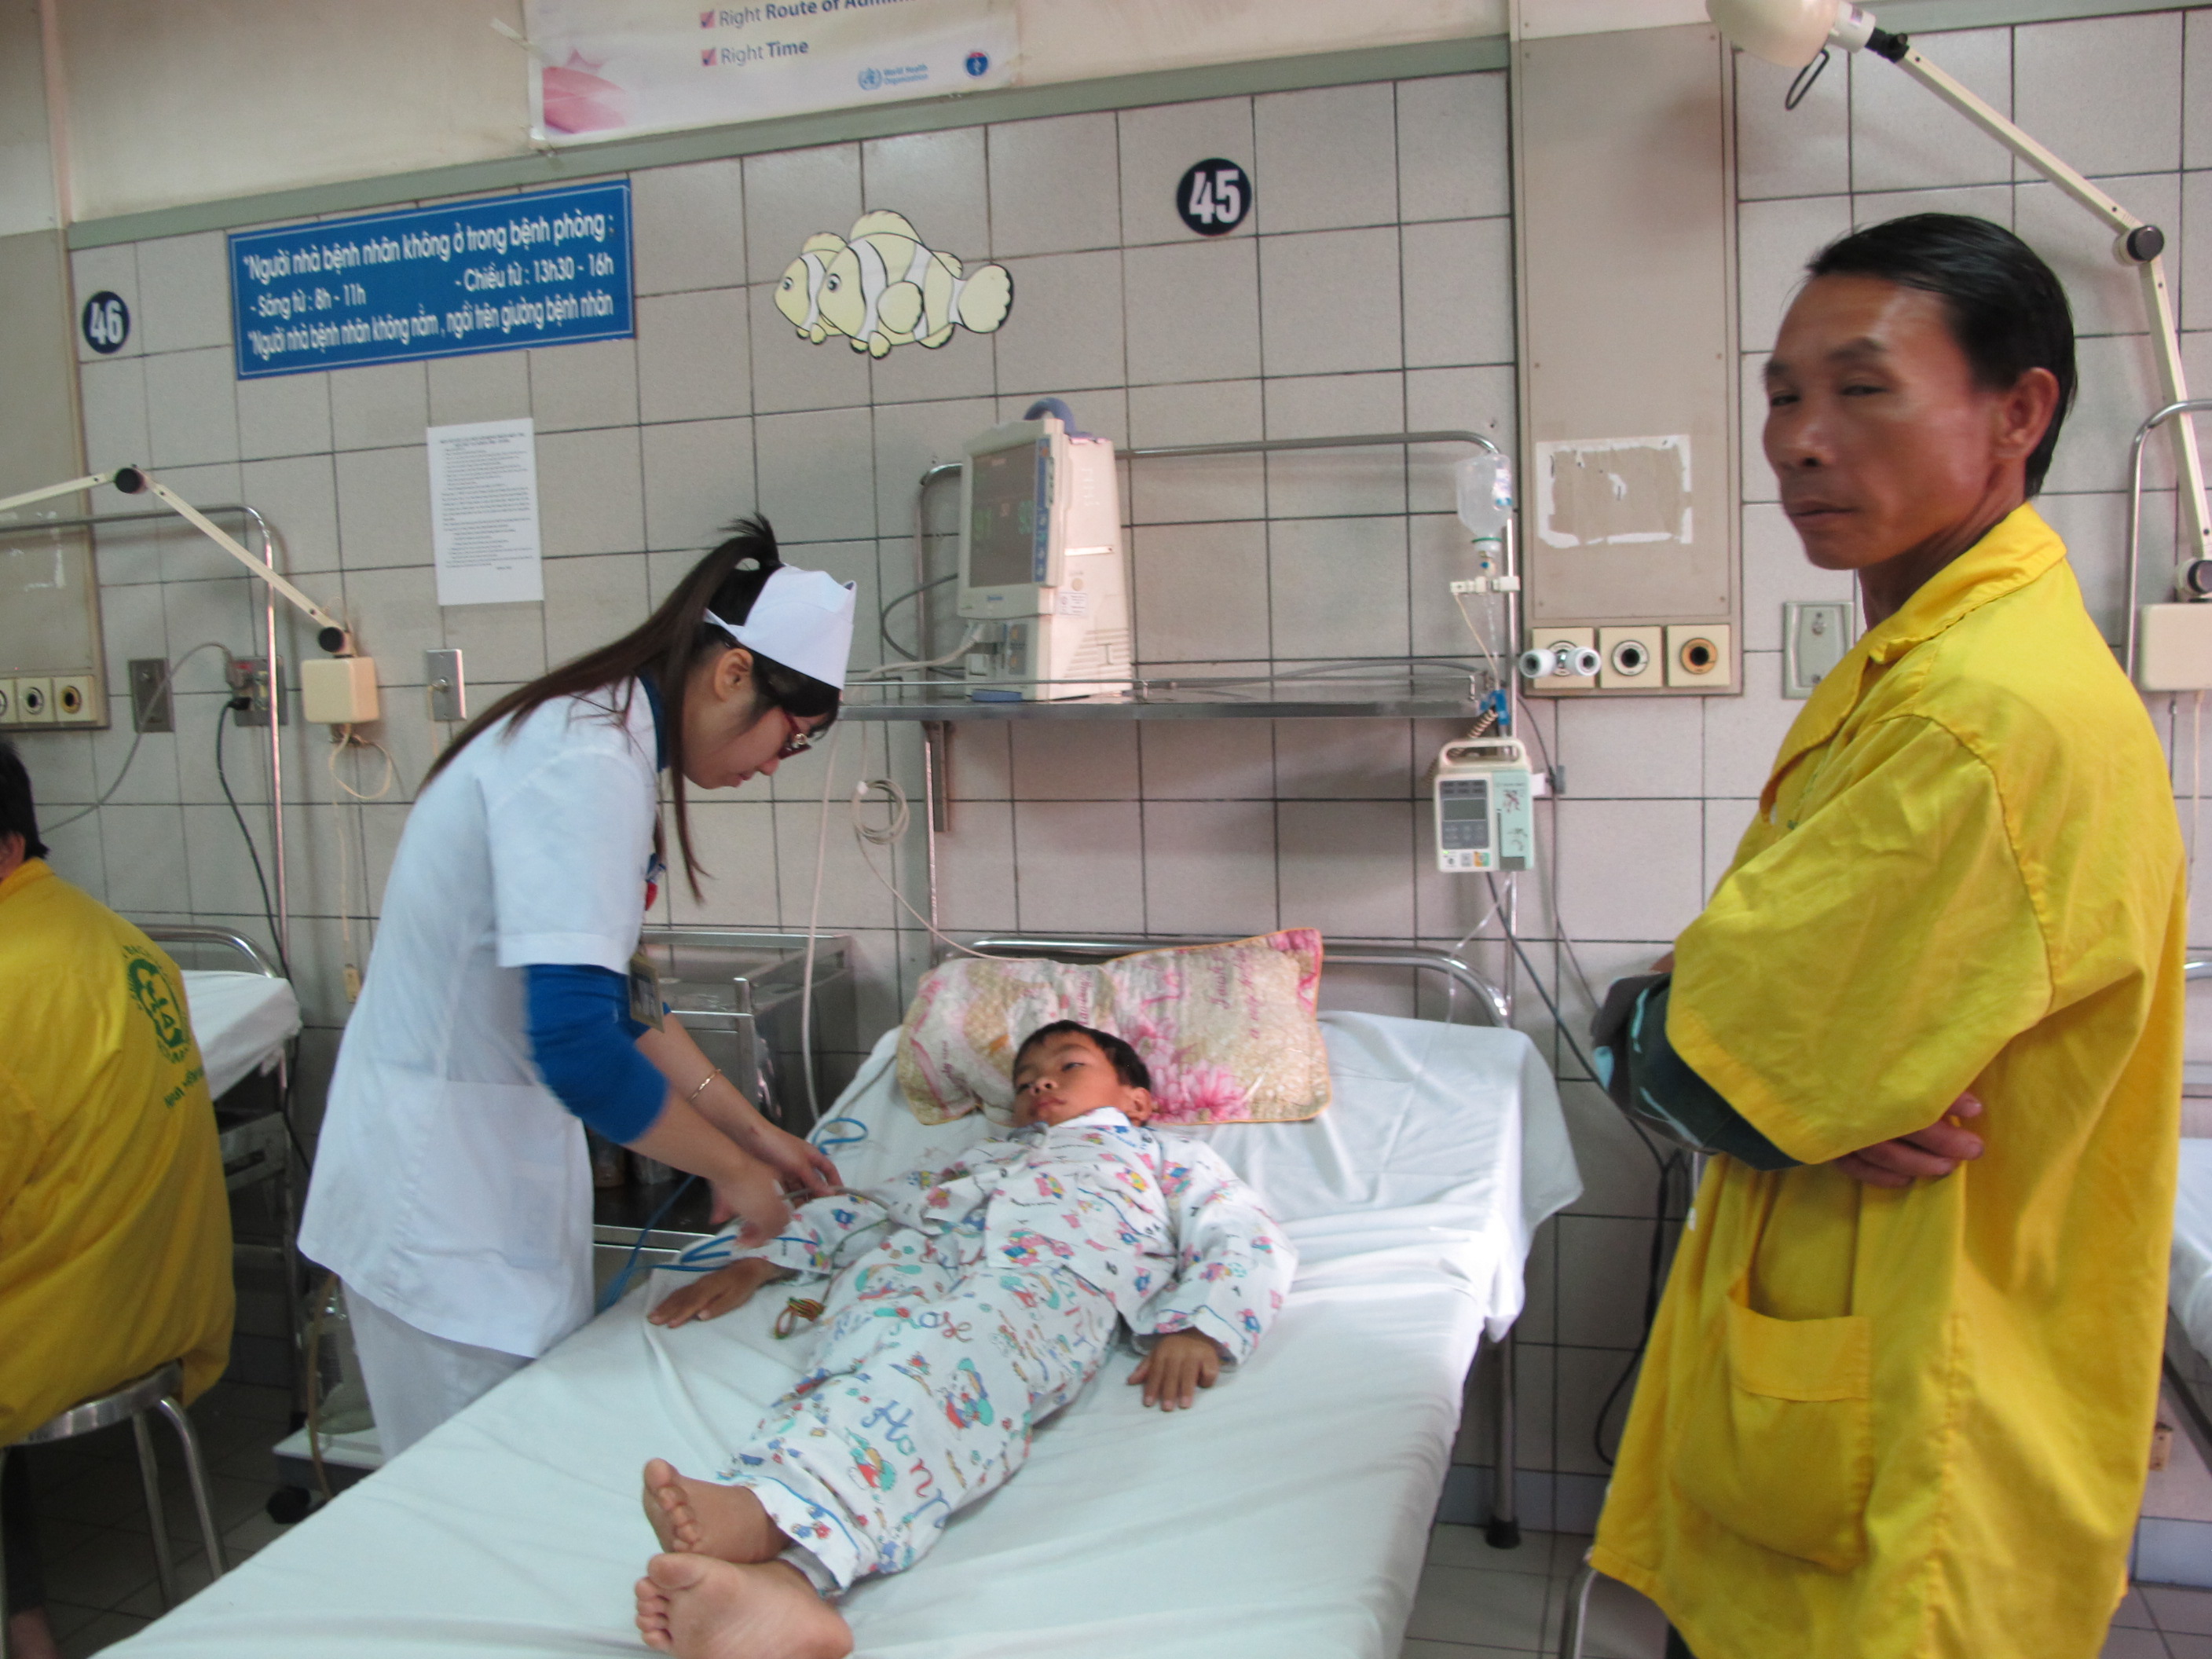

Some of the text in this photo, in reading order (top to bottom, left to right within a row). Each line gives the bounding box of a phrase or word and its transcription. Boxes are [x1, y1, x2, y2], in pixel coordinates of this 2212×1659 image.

[719, 8, 762, 29] Right
[765, 2, 819, 20] Route
[720, 41, 810, 67] Right Time
[1188, 169, 1241, 224] 45
[293, 244, 320, 274] nhà
[323, 241, 361, 275] bệnh
[362, 236, 401, 265] nhân
[402, 231, 451, 262] không
[467, 225, 507, 255] trong
[510, 216, 551, 251] bệnh
[553, 208, 605, 247] phòng
[463, 262, 506, 292] Chiều
[533, 256, 575, 284] 13h30
[588, 251, 614, 276] 16h
[89, 299, 124, 345] 46
[258, 293, 291, 320] Sáng
[315, 287, 332, 310] 8h
[343, 284, 367, 306] 11h
[287, 322, 309, 351] nhà
[309, 320, 341, 354] bệnh
[341, 317, 372, 345] nhân
[372, 313, 410, 346] không
[446, 300, 474, 339] ngồi
[474, 302, 500, 330] trên
[545, 292, 579, 328] bệnh
[580, 289, 614, 317] nhân
